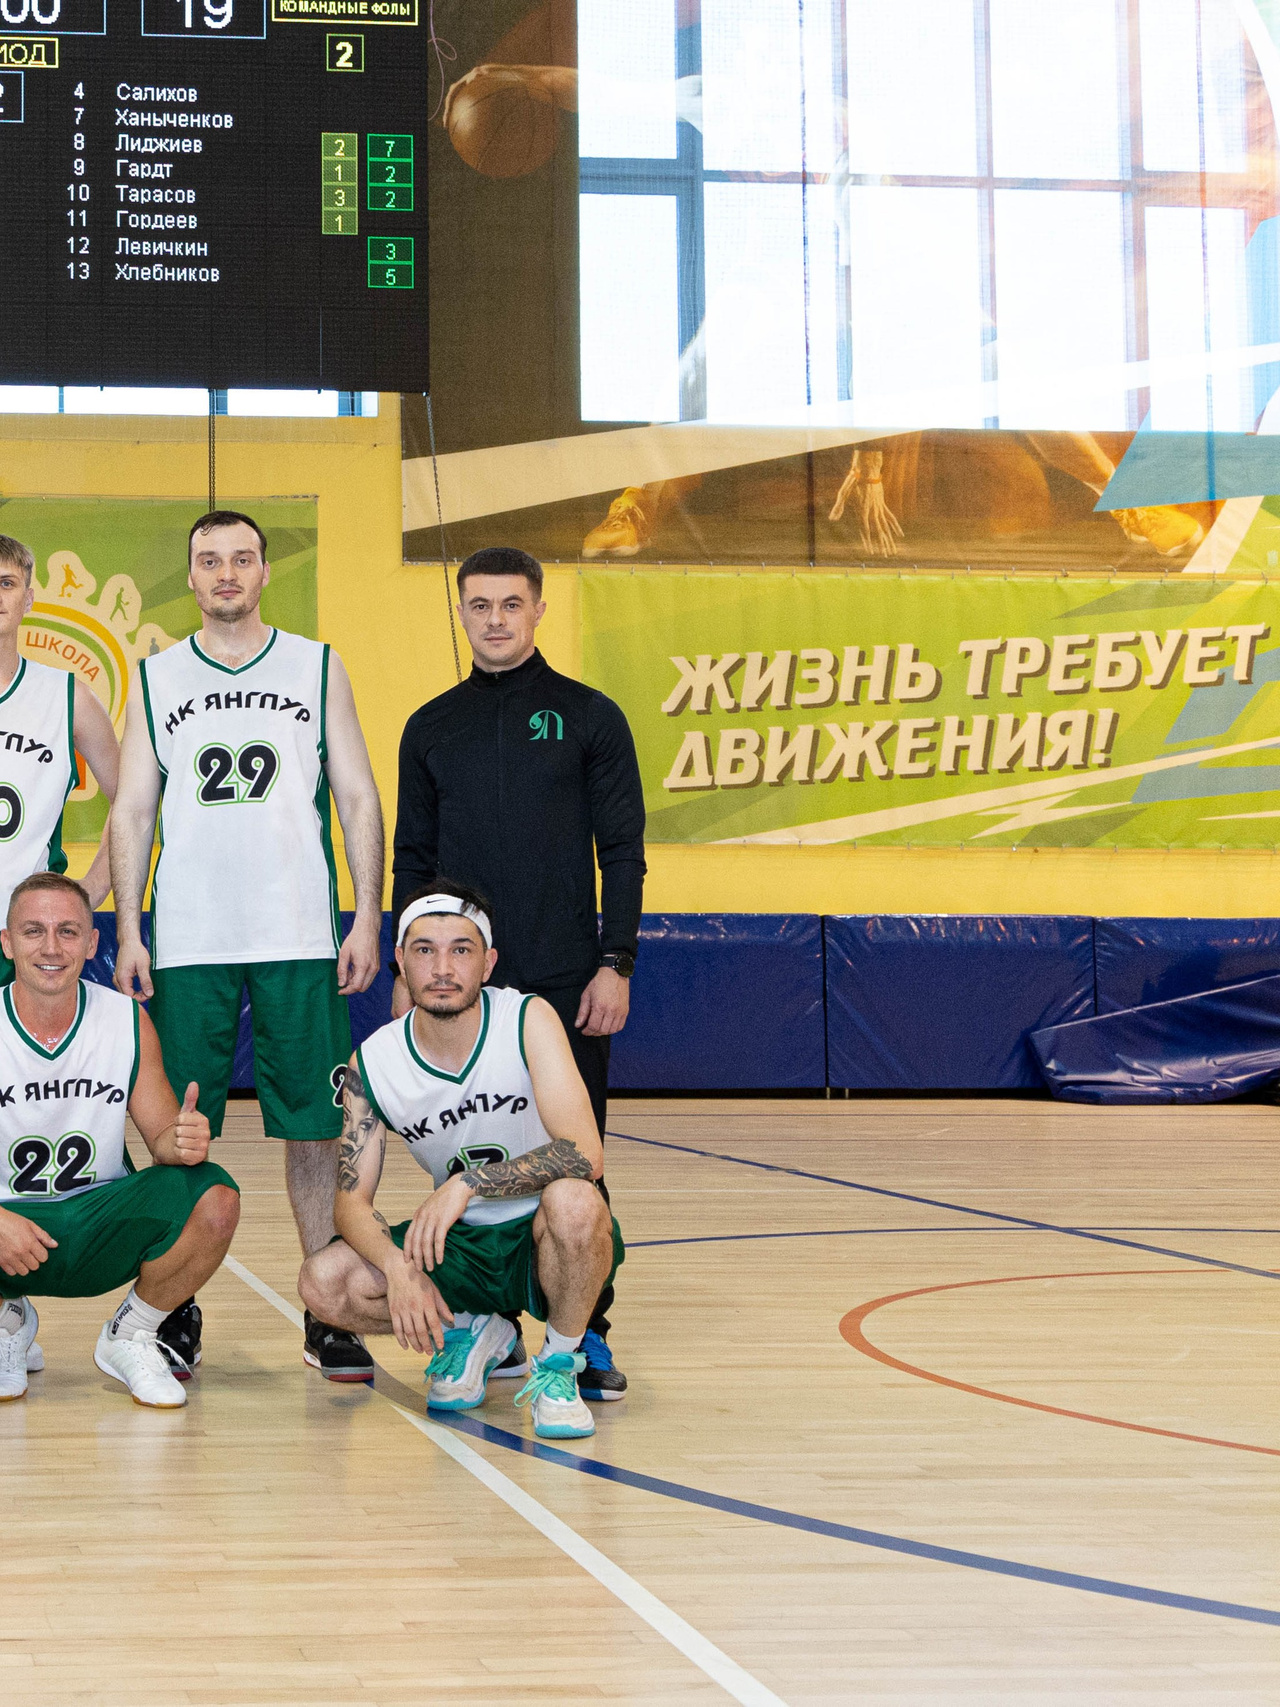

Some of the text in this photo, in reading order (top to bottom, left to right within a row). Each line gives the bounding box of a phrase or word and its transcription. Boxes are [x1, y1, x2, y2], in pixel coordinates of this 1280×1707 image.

[175, 0, 234, 29] 19
[279, 0, 411, 16] КОМАНДНЫЕ ФОЛЫ
[335, 41, 354, 68] 2
[73, 81, 198, 103] 4 Салихов
[73, 107, 234, 129] 7 Ханыченков
[73, 132, 395, 158] 8 Лиджиев 2 7
[73, 158, 396, 183] 9 Гардт 1 2
[66, 183, 396, 208] 10 Тарасов 3 2
[66, 209, 342, 232] 11 Гордеев 1
[66, 236, 396, 260] 12 Левичкин 3
[66, 261, 396, 286] 13 Хлебников 5
[25, 631, 100, 682] ШКОЛА
[661, 622, 1270, 717] ЖИЗНЬ ТРЕБУЕТ
[165, 691, 311, 736] НК ЯНГПУР
[662, 707, 1120, 792] ДВИЖЕНИЯ!
[194, 740, 281, 807] 29
[24, 1078, 125, 1105] ЯНГПУР
[399, 1116, 435, 1144] НК
[8, 1130, 97, 1197] 22
